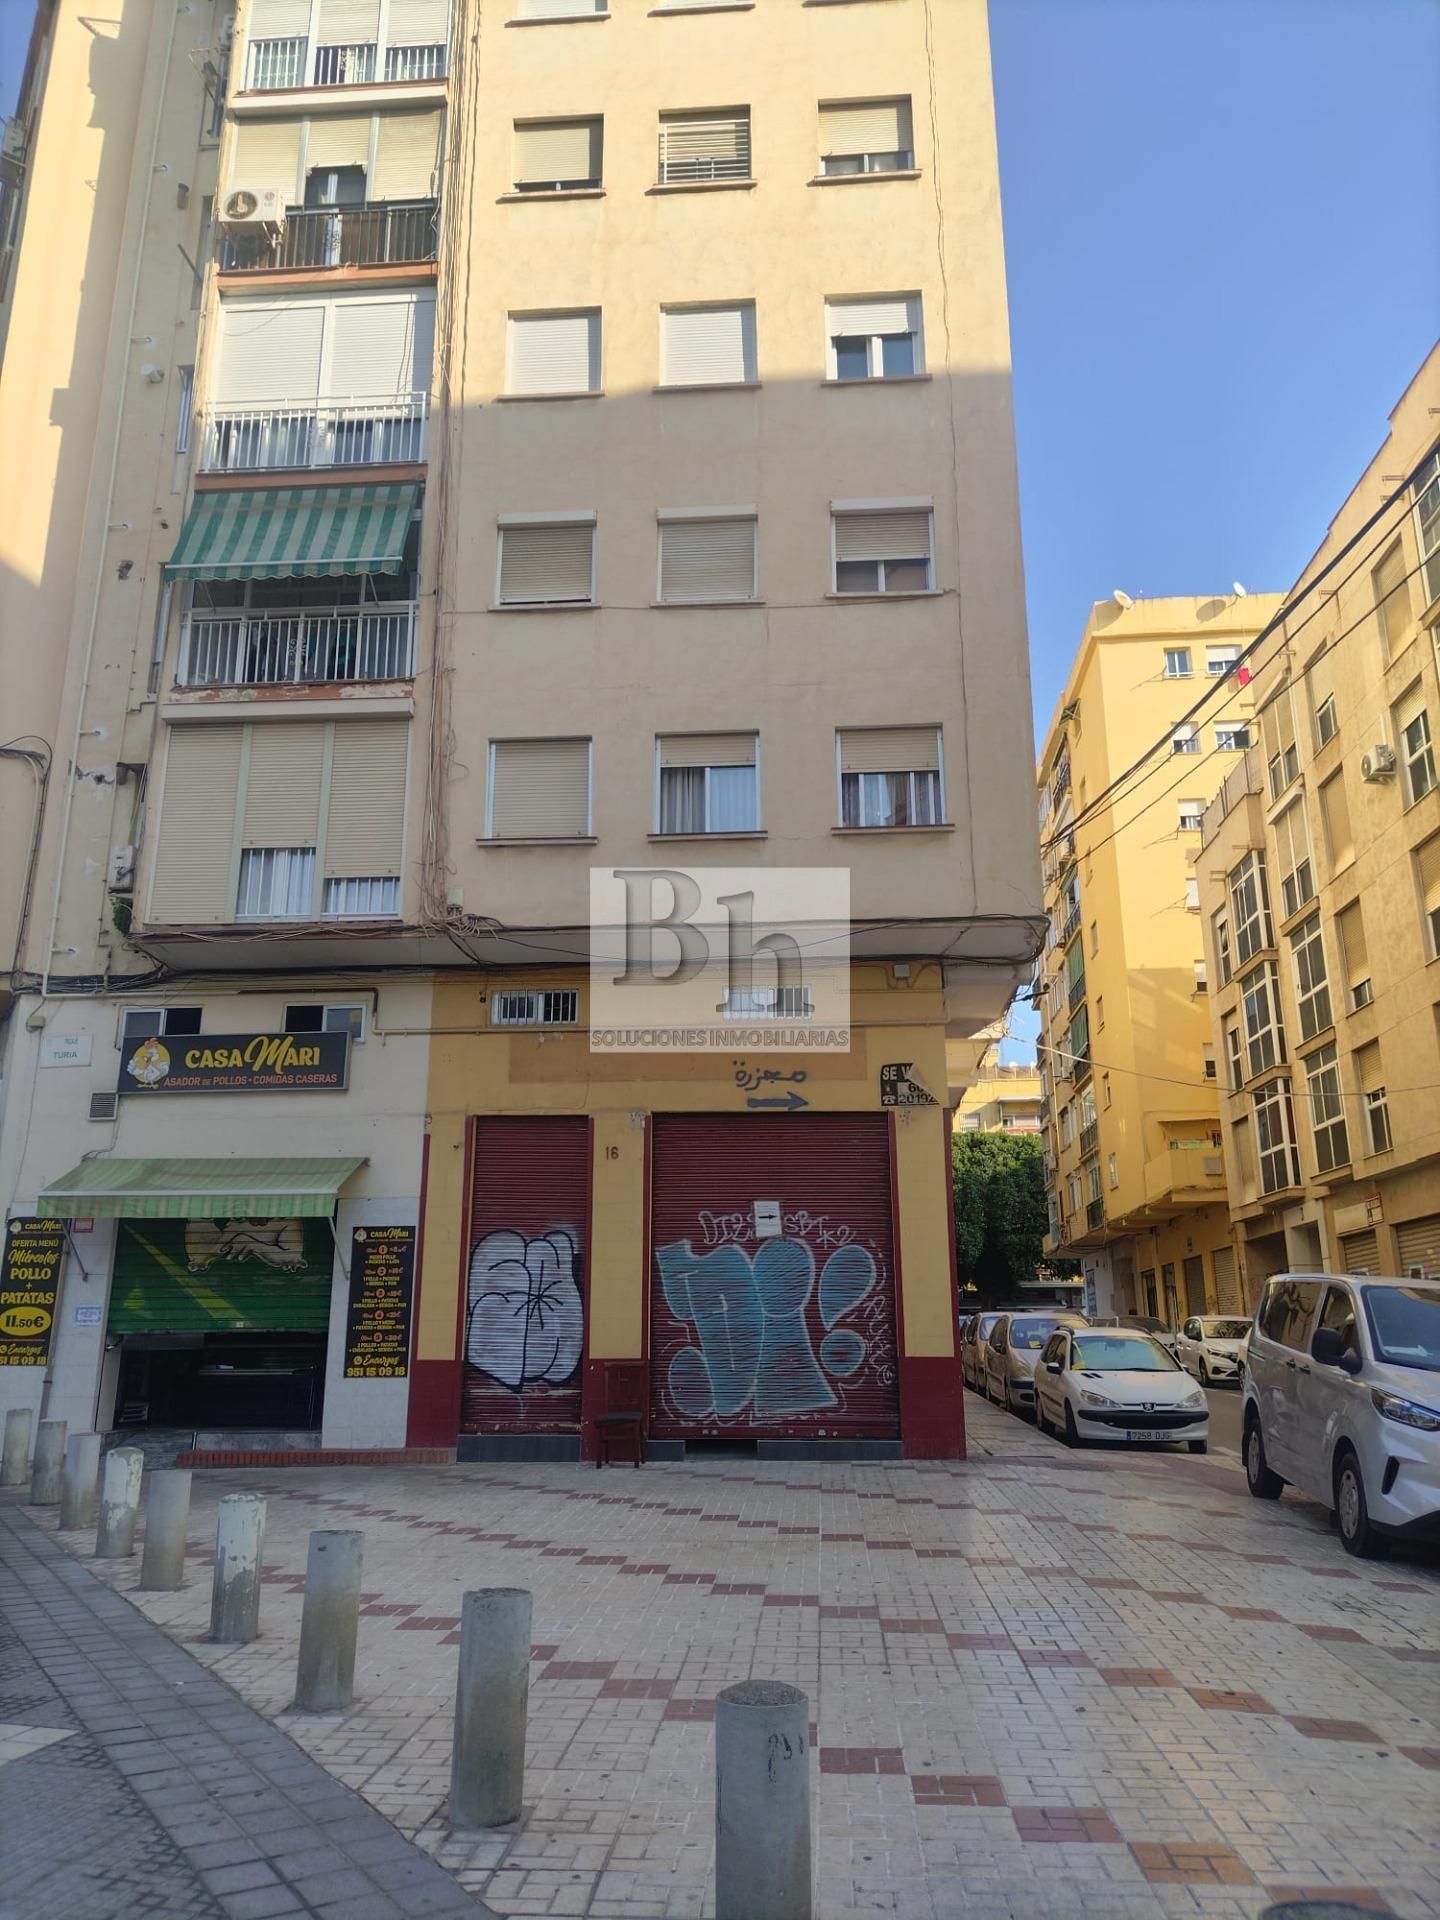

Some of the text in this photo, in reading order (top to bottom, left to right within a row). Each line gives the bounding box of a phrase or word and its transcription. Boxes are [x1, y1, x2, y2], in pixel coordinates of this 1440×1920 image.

[184, 1048, 243, 1069] CASA
[882, 1065, 898, 1081] SE
[163, 1076, 201, 1087] ASADOR
[212, 1075, 247, 1086] POLLOS
[252, 1074, 294, 1085] COMIDAS
[296, 1073, 337, 1084] CASERAS
[605, 1146, 620, 1160] 16
[11, 1239, 37, 1247] OFERTA
[10, 1267, 51, 1280] POLLO
[0, 1291, 54, 1304] PATATAS
[347, 1366, 406, 1377] 951 15 09 18
